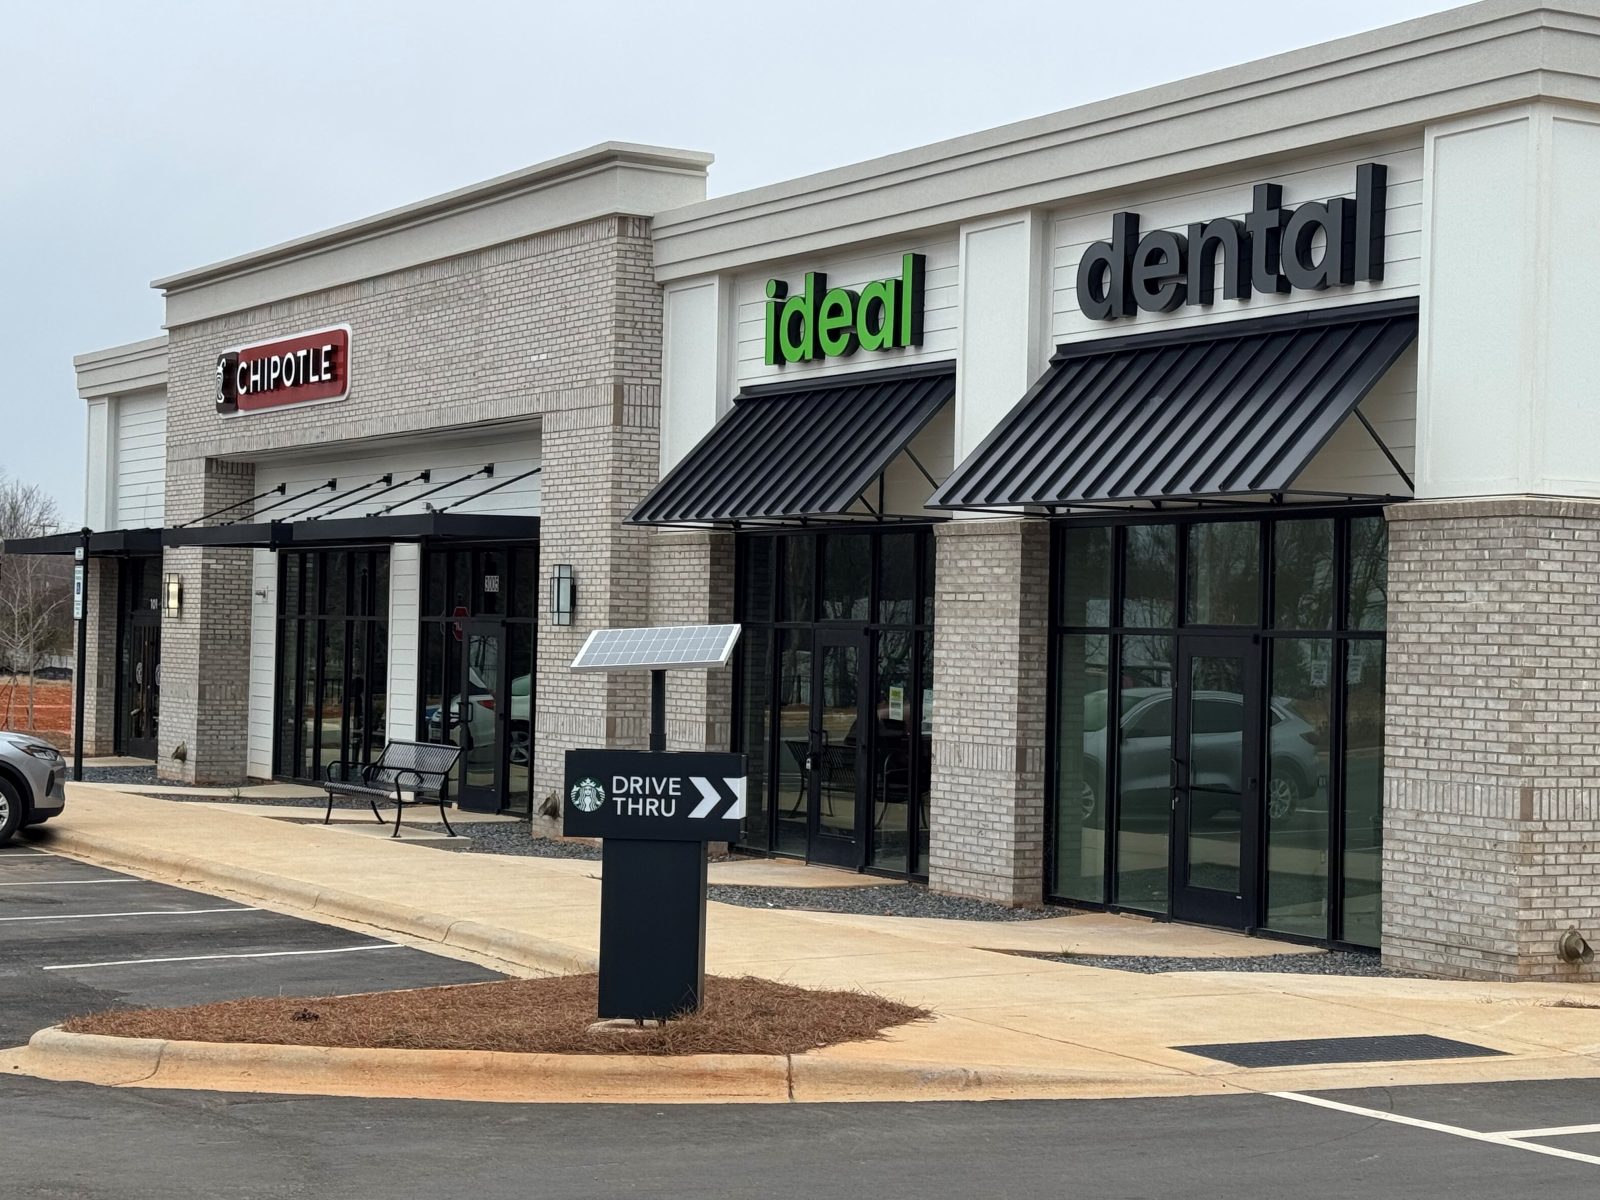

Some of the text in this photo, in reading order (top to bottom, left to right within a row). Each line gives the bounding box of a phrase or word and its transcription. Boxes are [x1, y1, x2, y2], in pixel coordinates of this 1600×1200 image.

[765, 164, 1386, 365] ideal dental
[236, 344, 332, 395] CHIPOTLE
[612, 776, 681, 795] DRIVE
[612, 797, 676, 817] THRU
